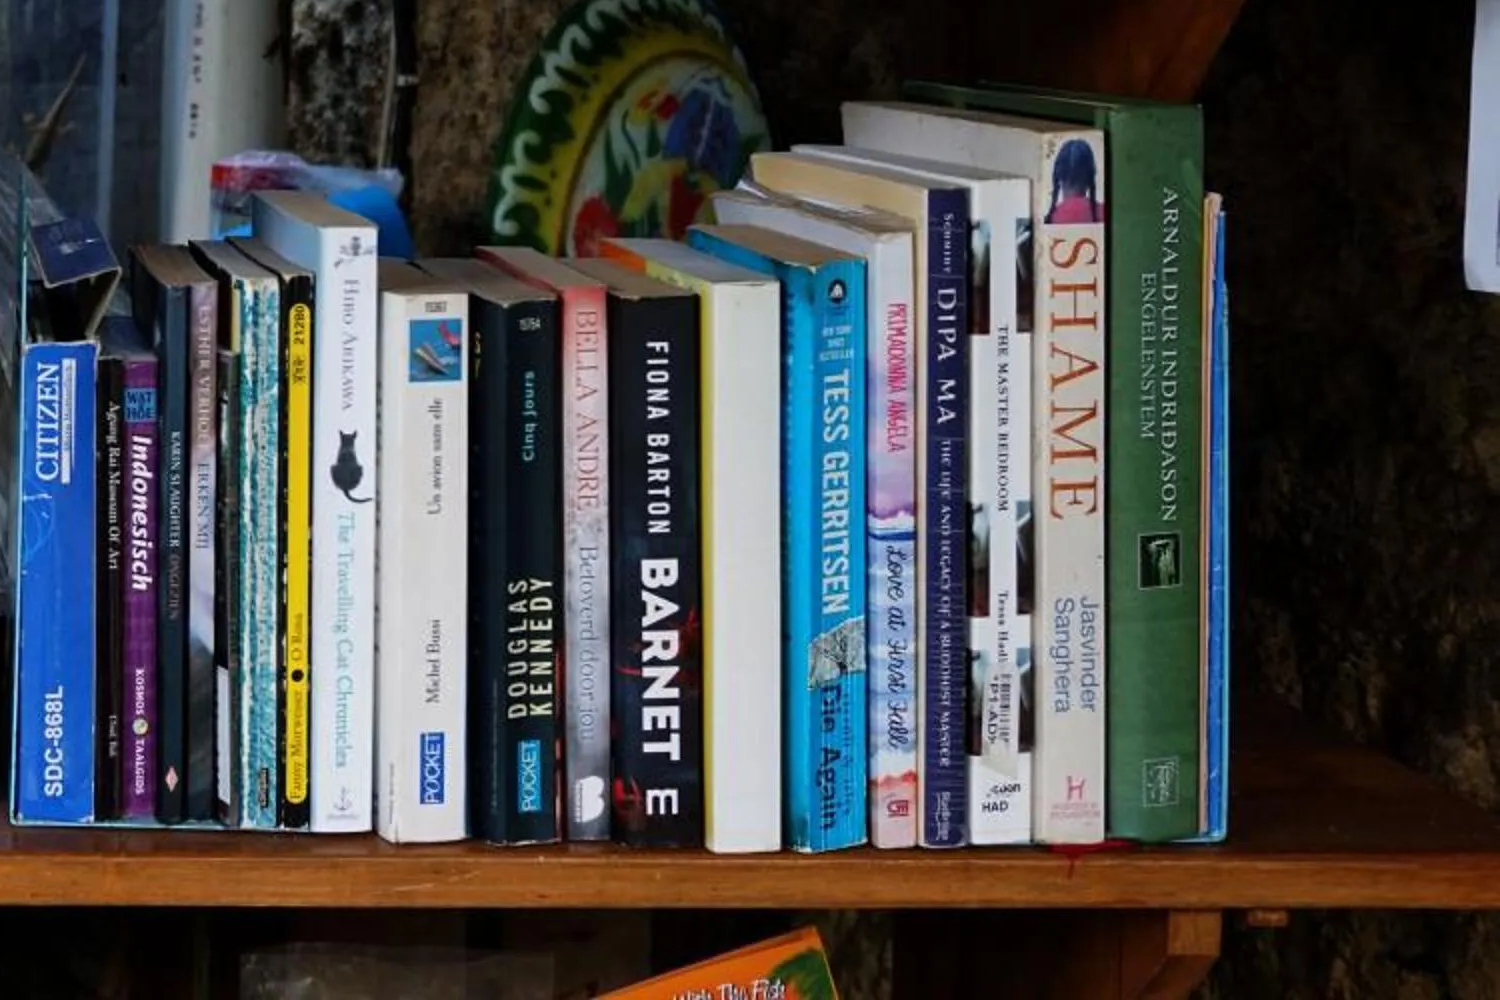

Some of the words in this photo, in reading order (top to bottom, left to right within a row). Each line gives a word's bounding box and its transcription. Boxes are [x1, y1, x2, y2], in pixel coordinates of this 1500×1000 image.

[1160, 186, 1179, 342] ARNALDUR
[294, 304, 307, 346] 21280
[575, 310, 598, 401] BELLA
[887, 302, 908, 395] PRIMADONNA
[937, 287, 957, 362] DIPA
[997, 325, 1009, 357] THE
[1139, 273, 1157, 439] ENGELENSTEM
[428, 397, 444, 420] elle
[646, 341, 670, 420] FIONA
[822, 367, 851, 444] TESS
[936, 378, 957, 424] MA
[997, 361, 1009, 427] MASTER
[1050, 237, 1100, 520] SHAME
[35, 362, 60, 481] CITIZEN
[105, 401, 121, 444] Agung
[169, 431, 181, 470] KARIN
[521, 422, 537, 462] Cinq
[887, 398, 908, 453] ANGELA
[940, 440, 952, 466] THE
[108, 446, 121, 468] Rai
[430, 455, 443, 490] avion
[576, 412, 600, 512] ANDRE
[647, 433, 671, 534] BARTON
[997, 432, 1009, 512] BEDROOM
[108, 471, 121, 524] Museum
[131, 434, 153, 591] Indonesisch
[169, 473, 181, 548] SLAUGHTER
[337, 511, 355, 544] The
[427, 493, 442, 515] Un
[940, 504, 952, 535] AND
[107, 548, 120, 569] Art
[821, 451, 851, 616] GERRITSEN
[940, 540, 952, 592] LEGACY
[333, 550, 355, 634] Travelling
[578, 546, 599, 643] Betoverd
[885, 544, 906, 602] Love
[337, 639, 355, 670] Cat
[425, 618, 442, 654] Bussi
[507, 579, 528, 719] DOUGLAS
[530, 577, 553, 717] KENNEDY
[641, 558, 681, 761] BARNET
[939, 633, 951, 706] BUDDHIST
[1050, 597, 1075, 713] Sanghera
[1078, 595, 1100, 713] Jasvinder
[134, 667, 146, 716] KOSMOS
[425, 658, 442, 704] Michel
[578, 649, 599, 703] door
[44, 684, 64, 797] SDC-868L
[335, 675, 354, 769] Chronicles
[134, 738, 147, 796] TAALGIDS
[423, 734, 442, 803] POCKET
[521, 741, 539, 811] POCKET
[815, 746, 842, 830] Again
